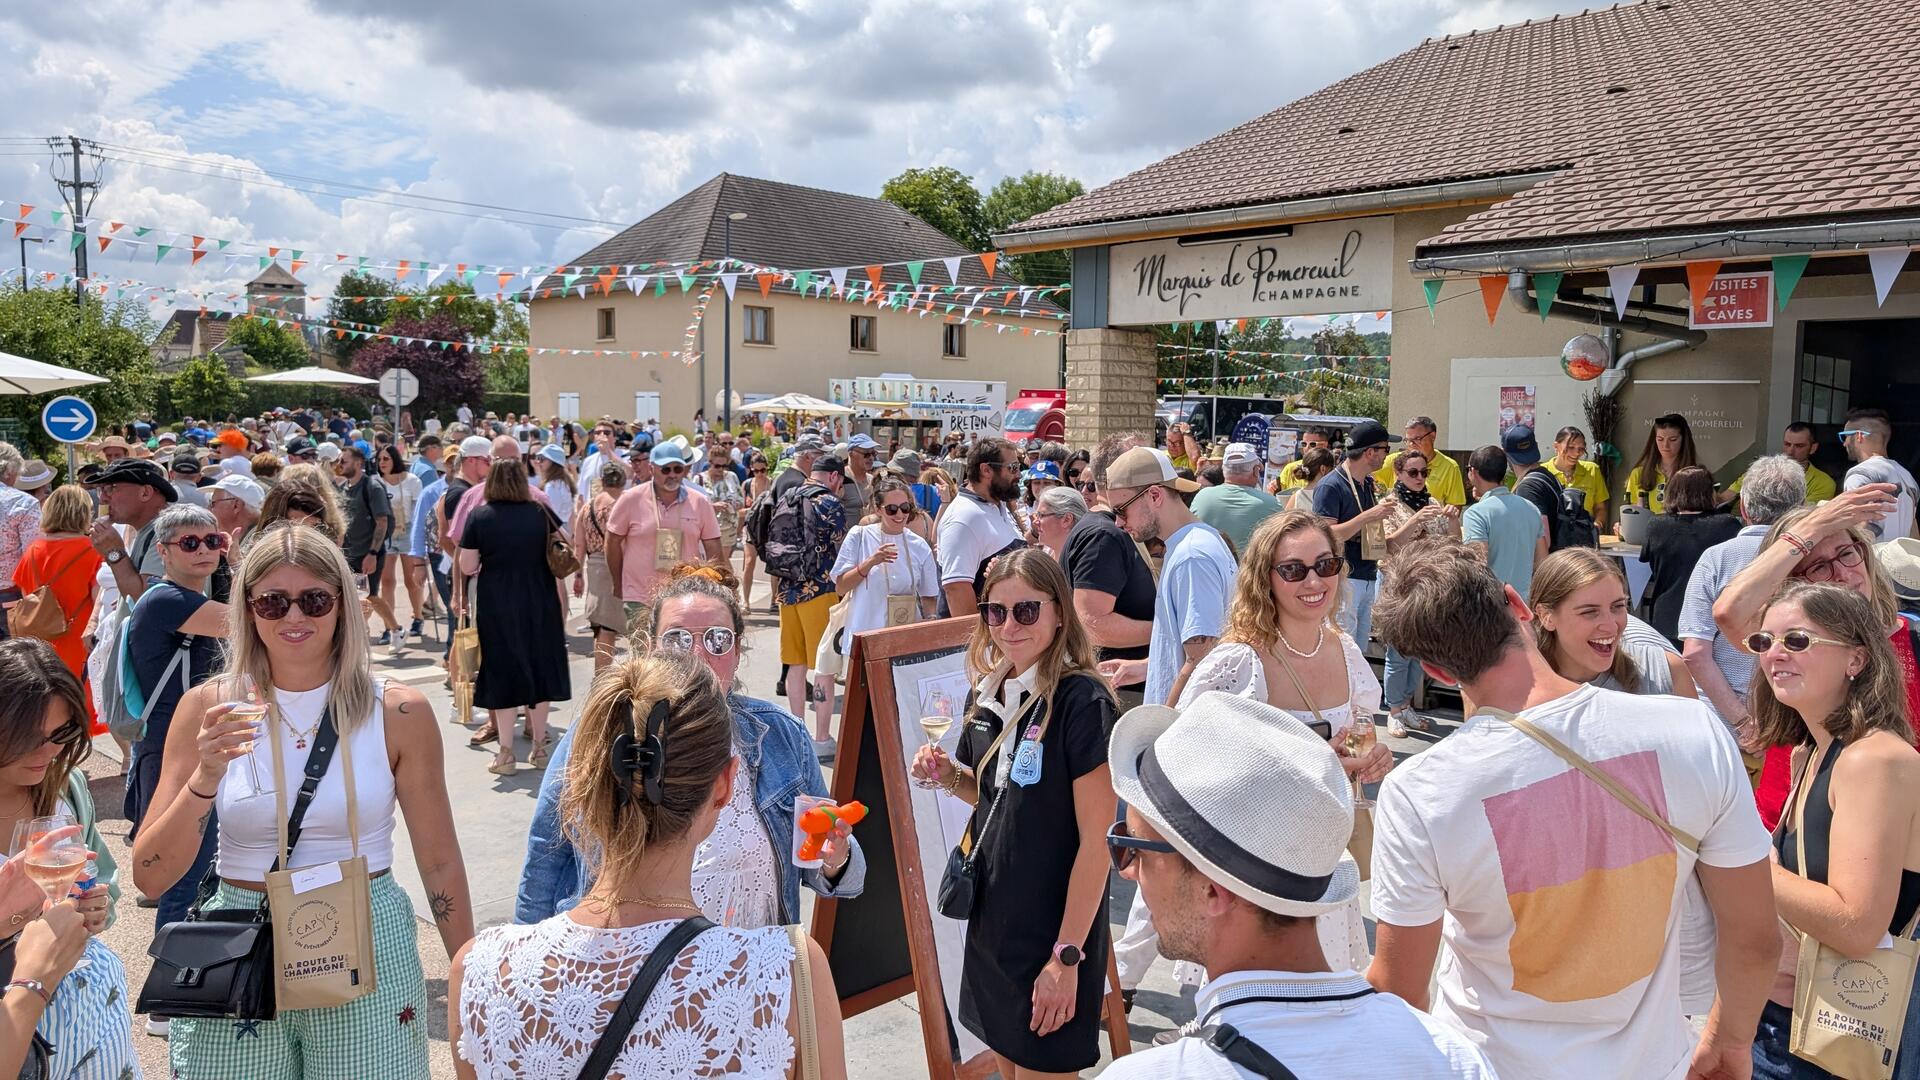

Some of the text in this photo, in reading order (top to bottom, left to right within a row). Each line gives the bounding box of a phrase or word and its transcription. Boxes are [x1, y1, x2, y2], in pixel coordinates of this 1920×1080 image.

[1133, 230, 1362, 316] Marquis de Pomereuil
[1258, 285, 1360, 302] CHAMPAGNE
[1720, 295, 1737, 305] DE
[1707, 309, 1754, 320] CAVES
[950, 415, 987, 432] BRETON
[283, 962, 293, 970] LA
[296, 957, 327, 968] ROUTE
[331, 954, 344, 963] DU
[284, 961, 345, 978] CHAMPAGNE
[1817, 1017, 1883, 1042] CHAMPAGNE
[1818, 1009, 1884, 1034] LA ROUTE DU
